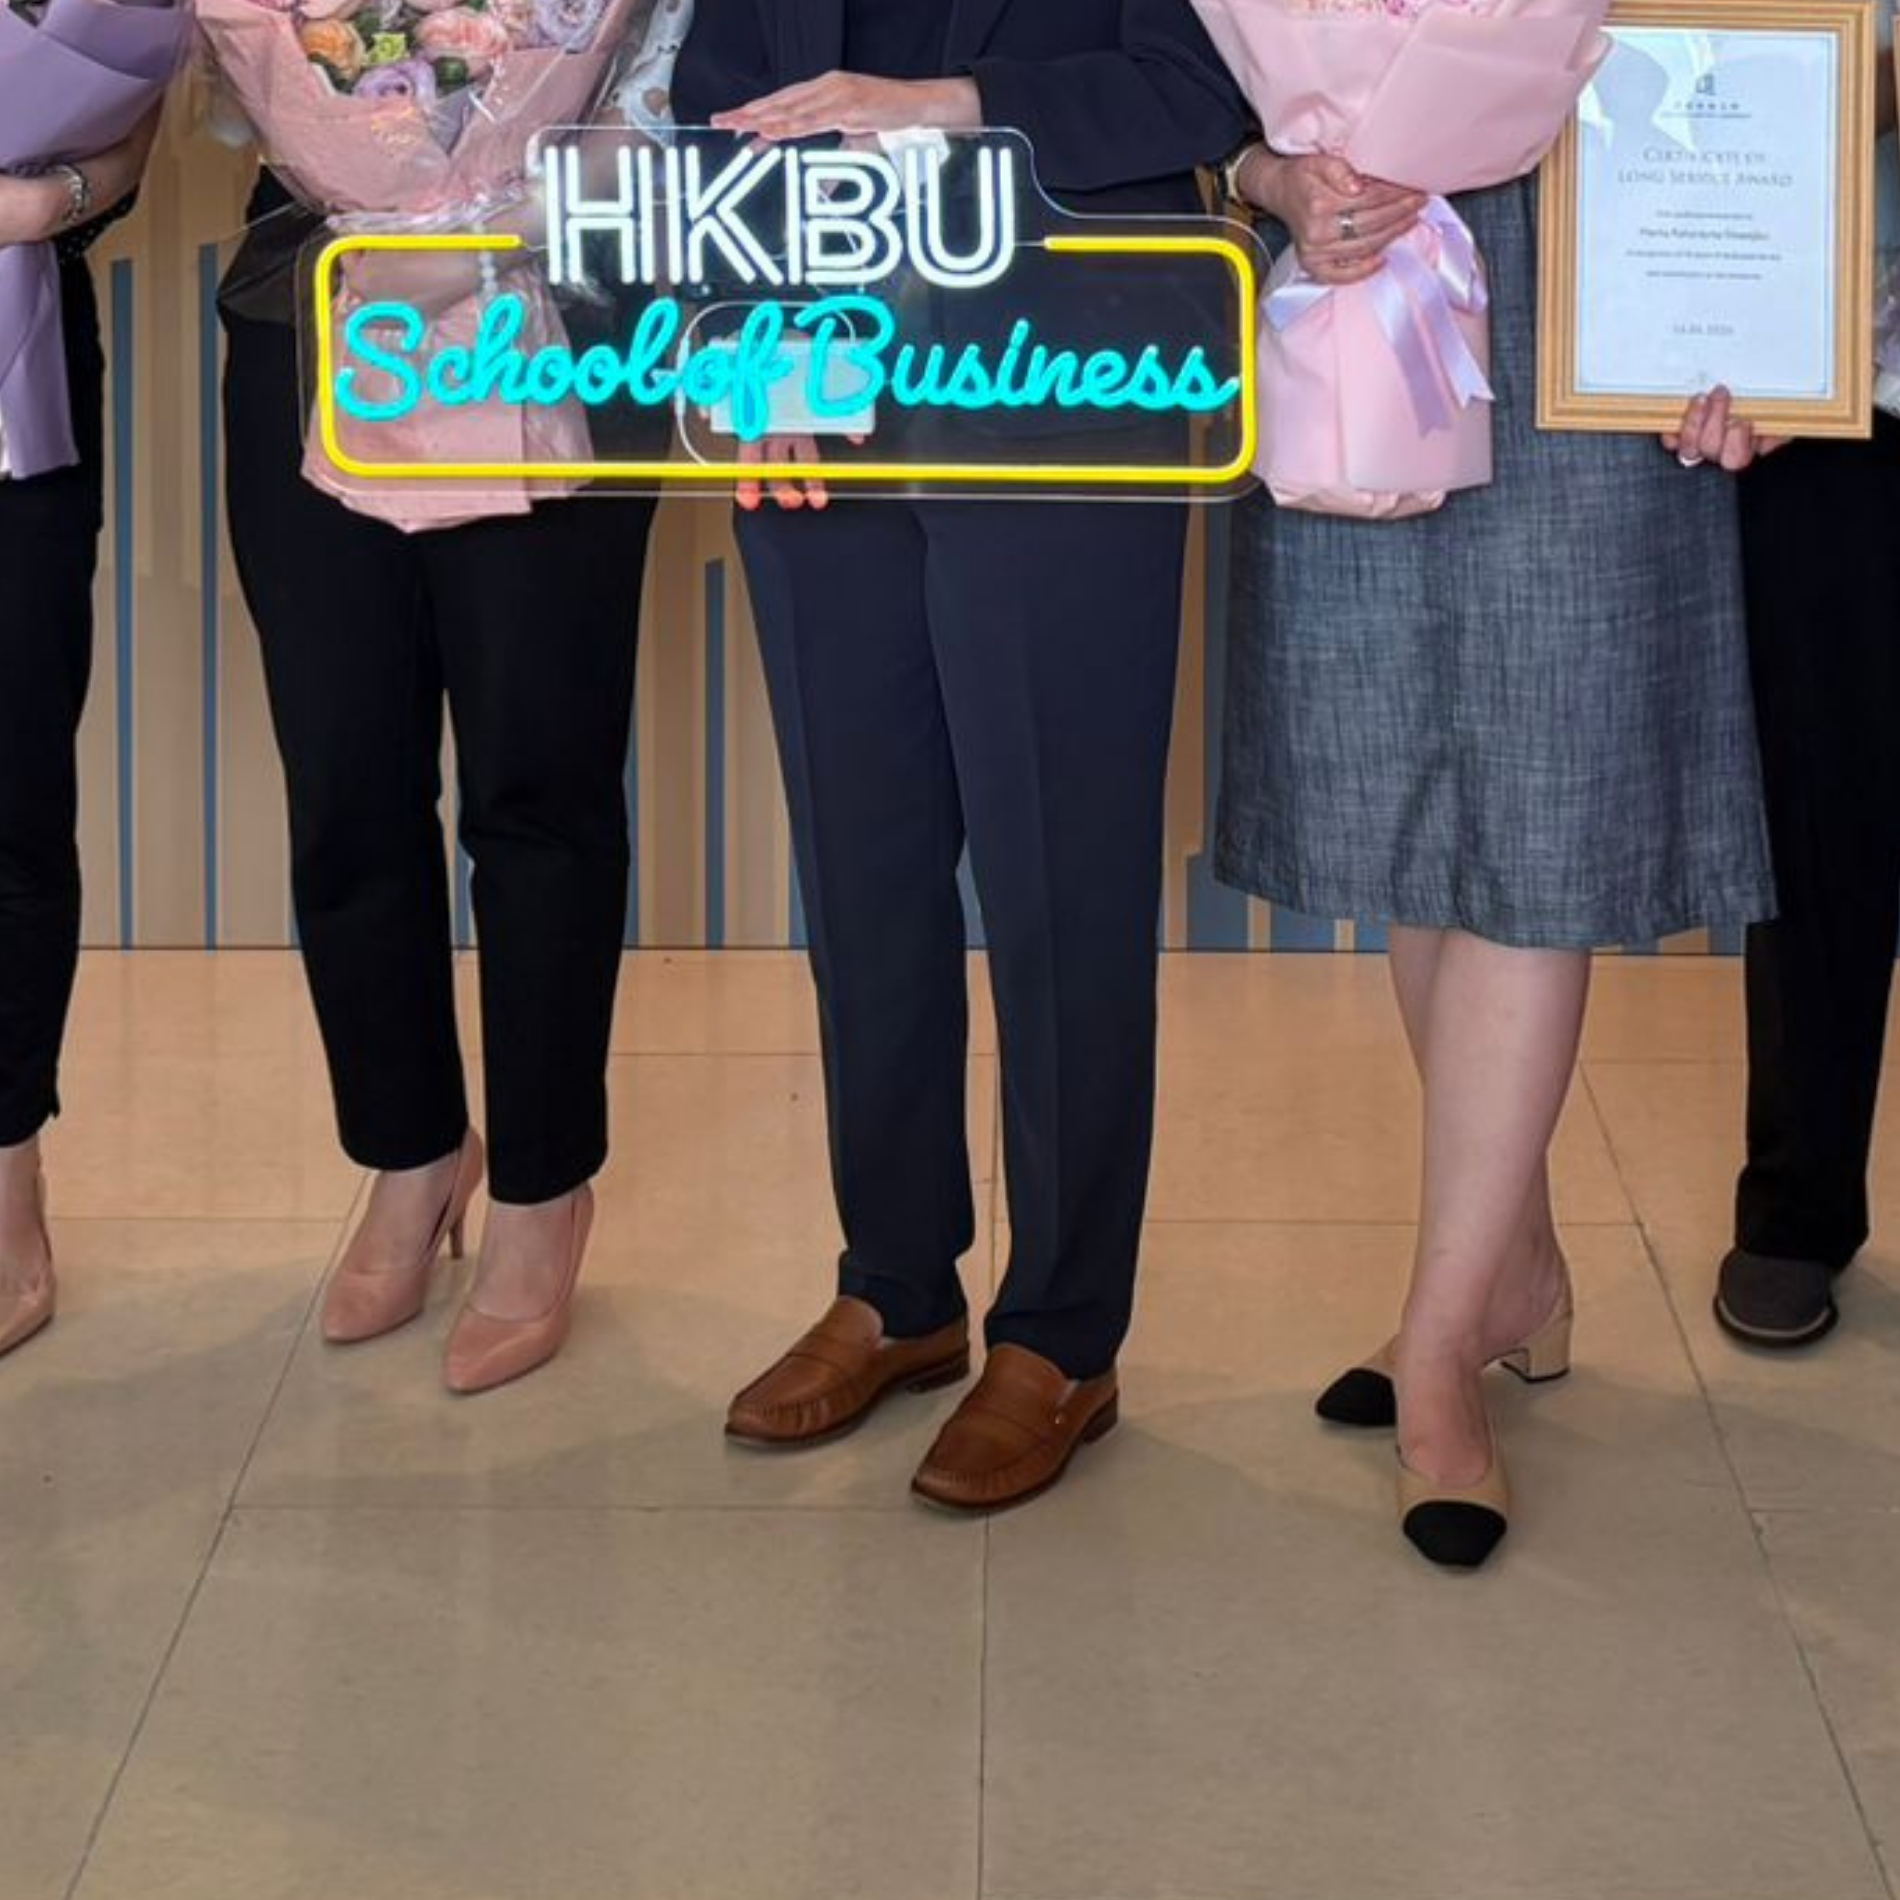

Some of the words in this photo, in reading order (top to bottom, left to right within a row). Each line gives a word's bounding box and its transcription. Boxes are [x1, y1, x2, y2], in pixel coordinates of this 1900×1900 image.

[543, 145, 1017, 290] HKBU
[334, 292, 681, 423] School
[680, 298, 795, 442] of
[793, 294, 1241, 419] Business
